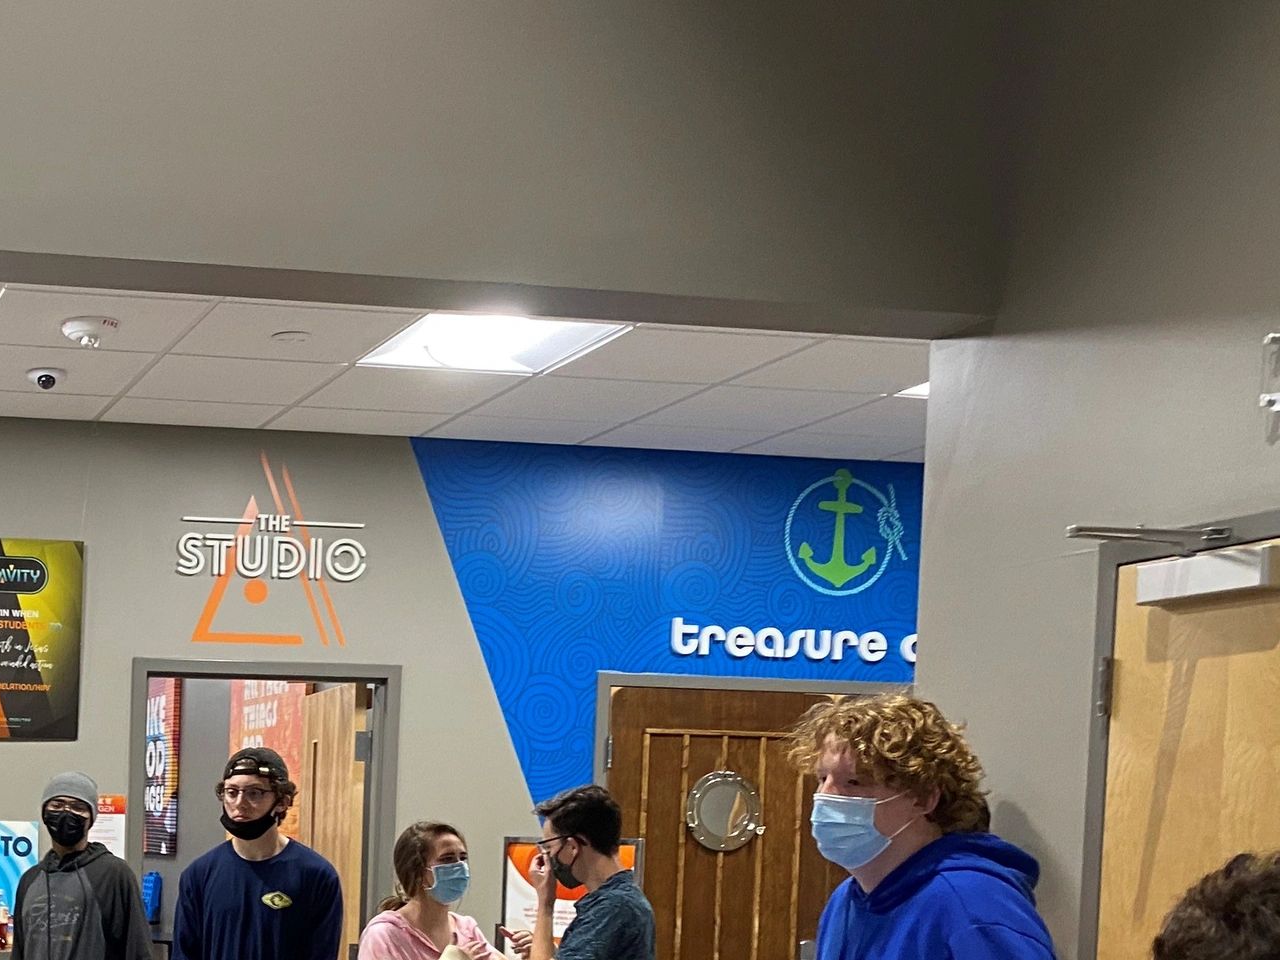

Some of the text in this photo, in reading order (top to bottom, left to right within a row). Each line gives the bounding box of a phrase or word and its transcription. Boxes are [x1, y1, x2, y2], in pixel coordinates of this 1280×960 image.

[257, 514, 291, 533] THE
[177, 532, 367, 583] STUDIO
[12, 609, 40, 619] WHEN
[671, 616, 888, 663] treasure
[0, 835, 33, 858] TO
